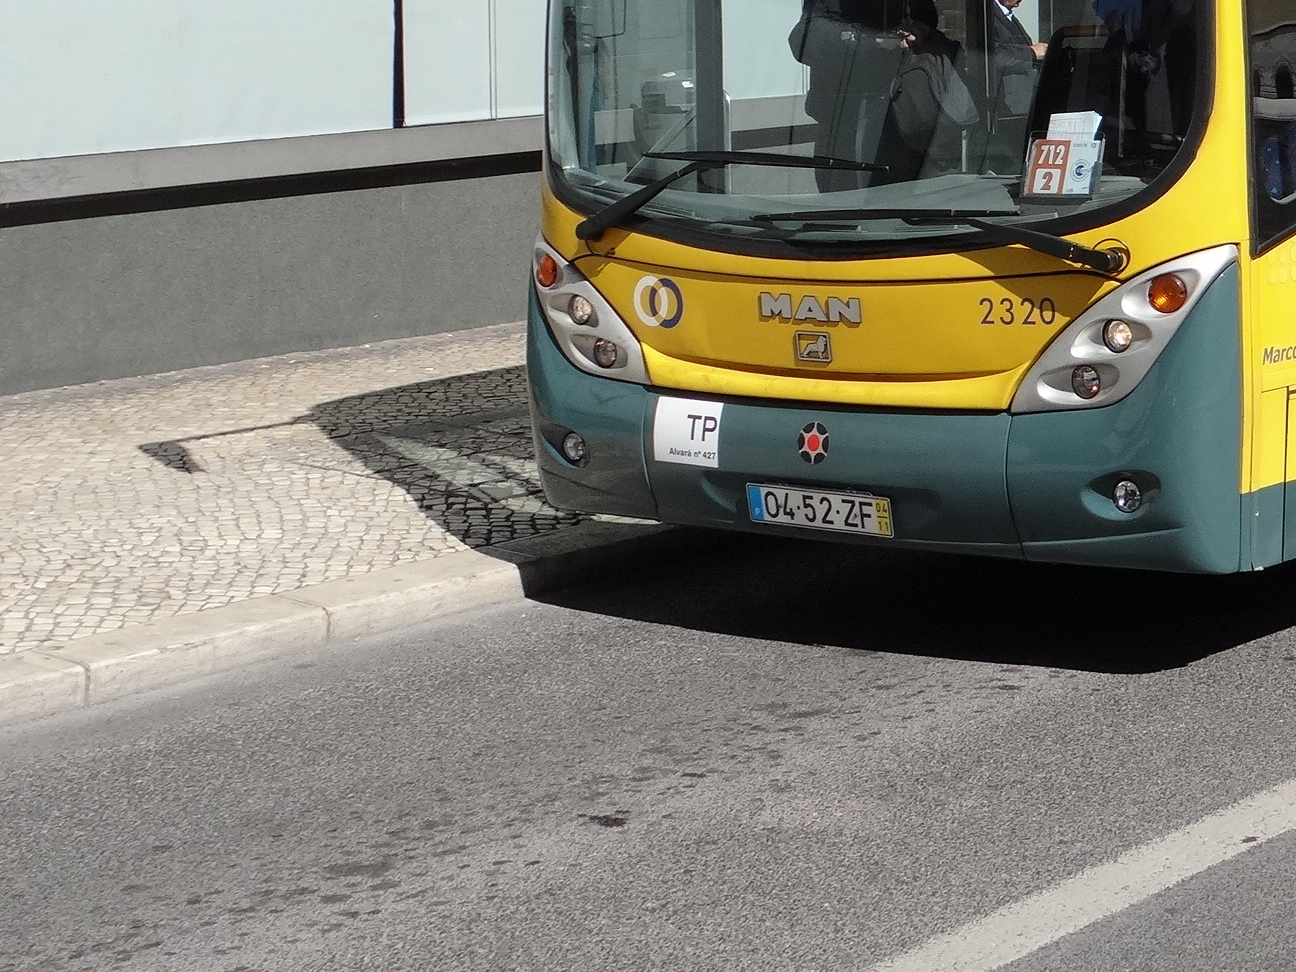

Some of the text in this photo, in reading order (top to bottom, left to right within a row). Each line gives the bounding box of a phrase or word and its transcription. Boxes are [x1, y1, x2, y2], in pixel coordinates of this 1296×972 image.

[1037, 144, 1066, 165] 712
[1040, 171, 1054, 191] 2
[759, 291, 862, 326] MAN
[979, 297, 1057, 326] 2320
[687, 414, 718, 441] TP
[669, 447, 692, 458] Alvará
[702, 451, 716, 460] 427
[875, 502, 887, 514] 04
